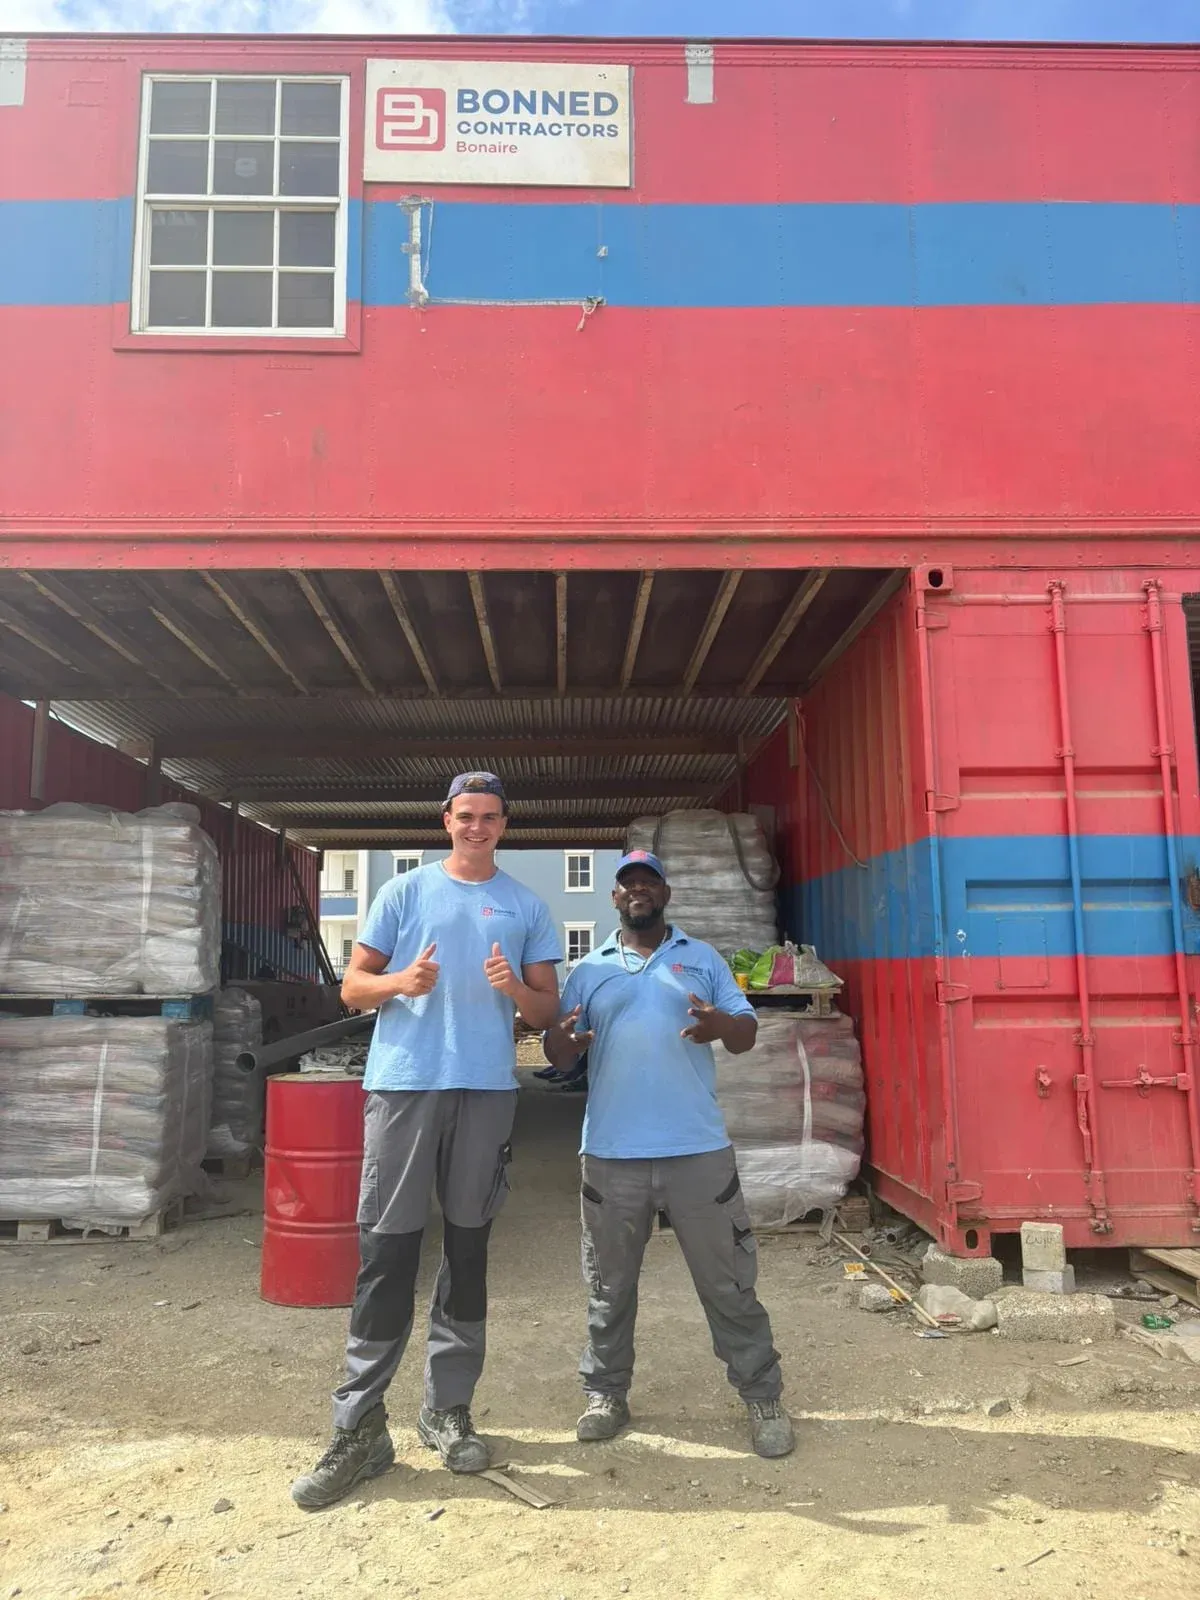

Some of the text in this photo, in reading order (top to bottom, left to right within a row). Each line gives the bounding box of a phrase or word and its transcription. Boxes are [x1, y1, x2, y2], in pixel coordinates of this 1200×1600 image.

[457, 89, 619, 116] BONNED
[457, 121, 619, 138] CONTRACTORS
[456, 141, 518, 154] Bonaire
